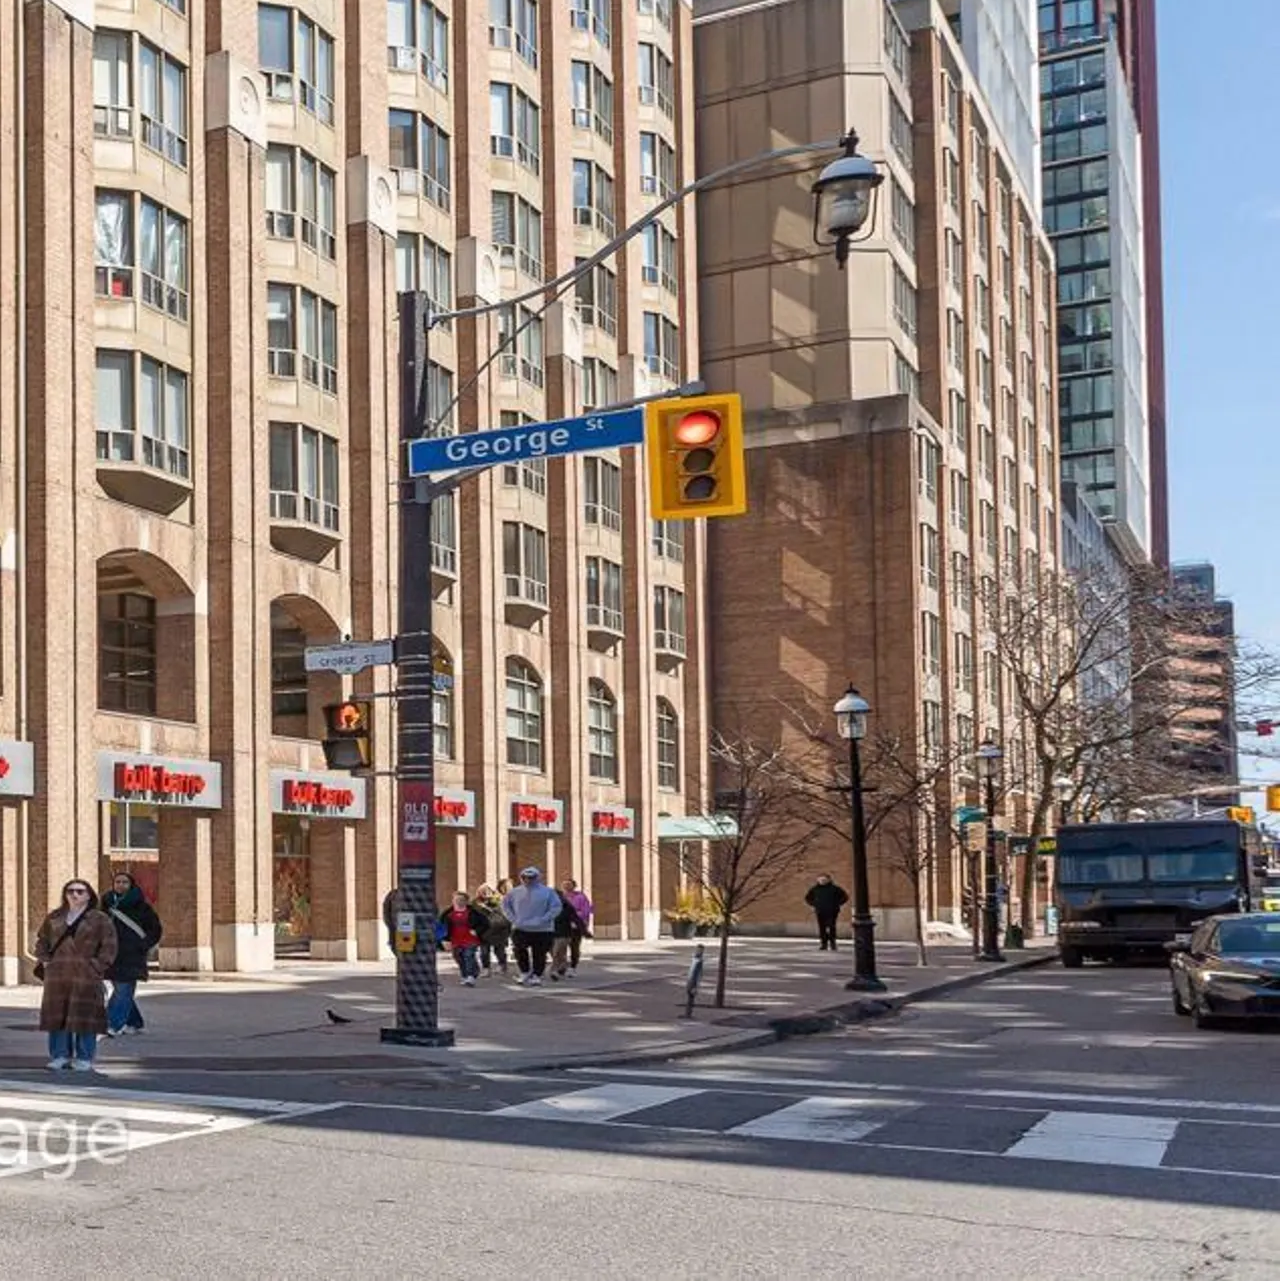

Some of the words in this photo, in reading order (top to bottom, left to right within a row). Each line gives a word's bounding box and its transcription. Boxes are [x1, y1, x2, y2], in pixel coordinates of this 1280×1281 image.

[446, 427, 570, 462] George
[585, 417, 604, 432] St
[120, 762, 157, 791] bulk
[160, 766, 197, 794] barn
